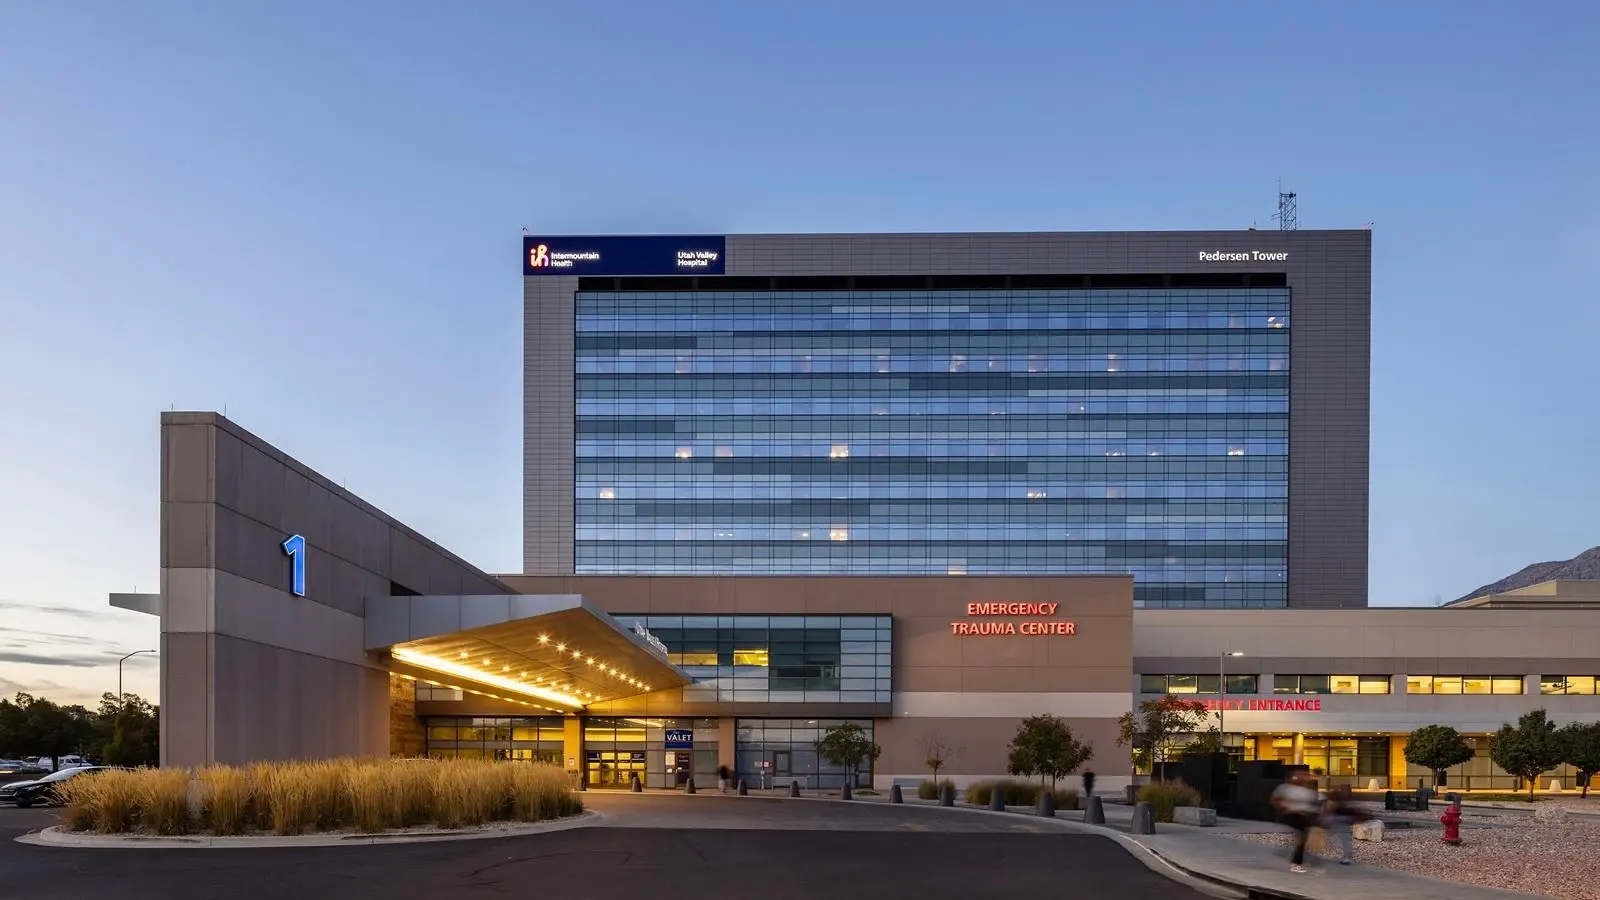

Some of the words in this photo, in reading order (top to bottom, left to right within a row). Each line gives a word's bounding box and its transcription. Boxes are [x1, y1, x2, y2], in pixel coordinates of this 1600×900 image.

[551, 252, 600, 260] Intermountain
[678, 251, 695, 259] Utah
[696, 251, 718, 260] Valley
[1199, 251, 1249, 261] Pedersen
[1252, 251, 1288, 261] Tower
[678, 259, 707, 267] Hospital
[283, 534, 305, 596] 1
[967, 602, 1058, 616] EMERGENCY
[951, 622, 1016, 636] TRAUMA
[1020, 622, 1075, 636] CENTER
[1249, 699, 1321, 711] ENTRANCE
